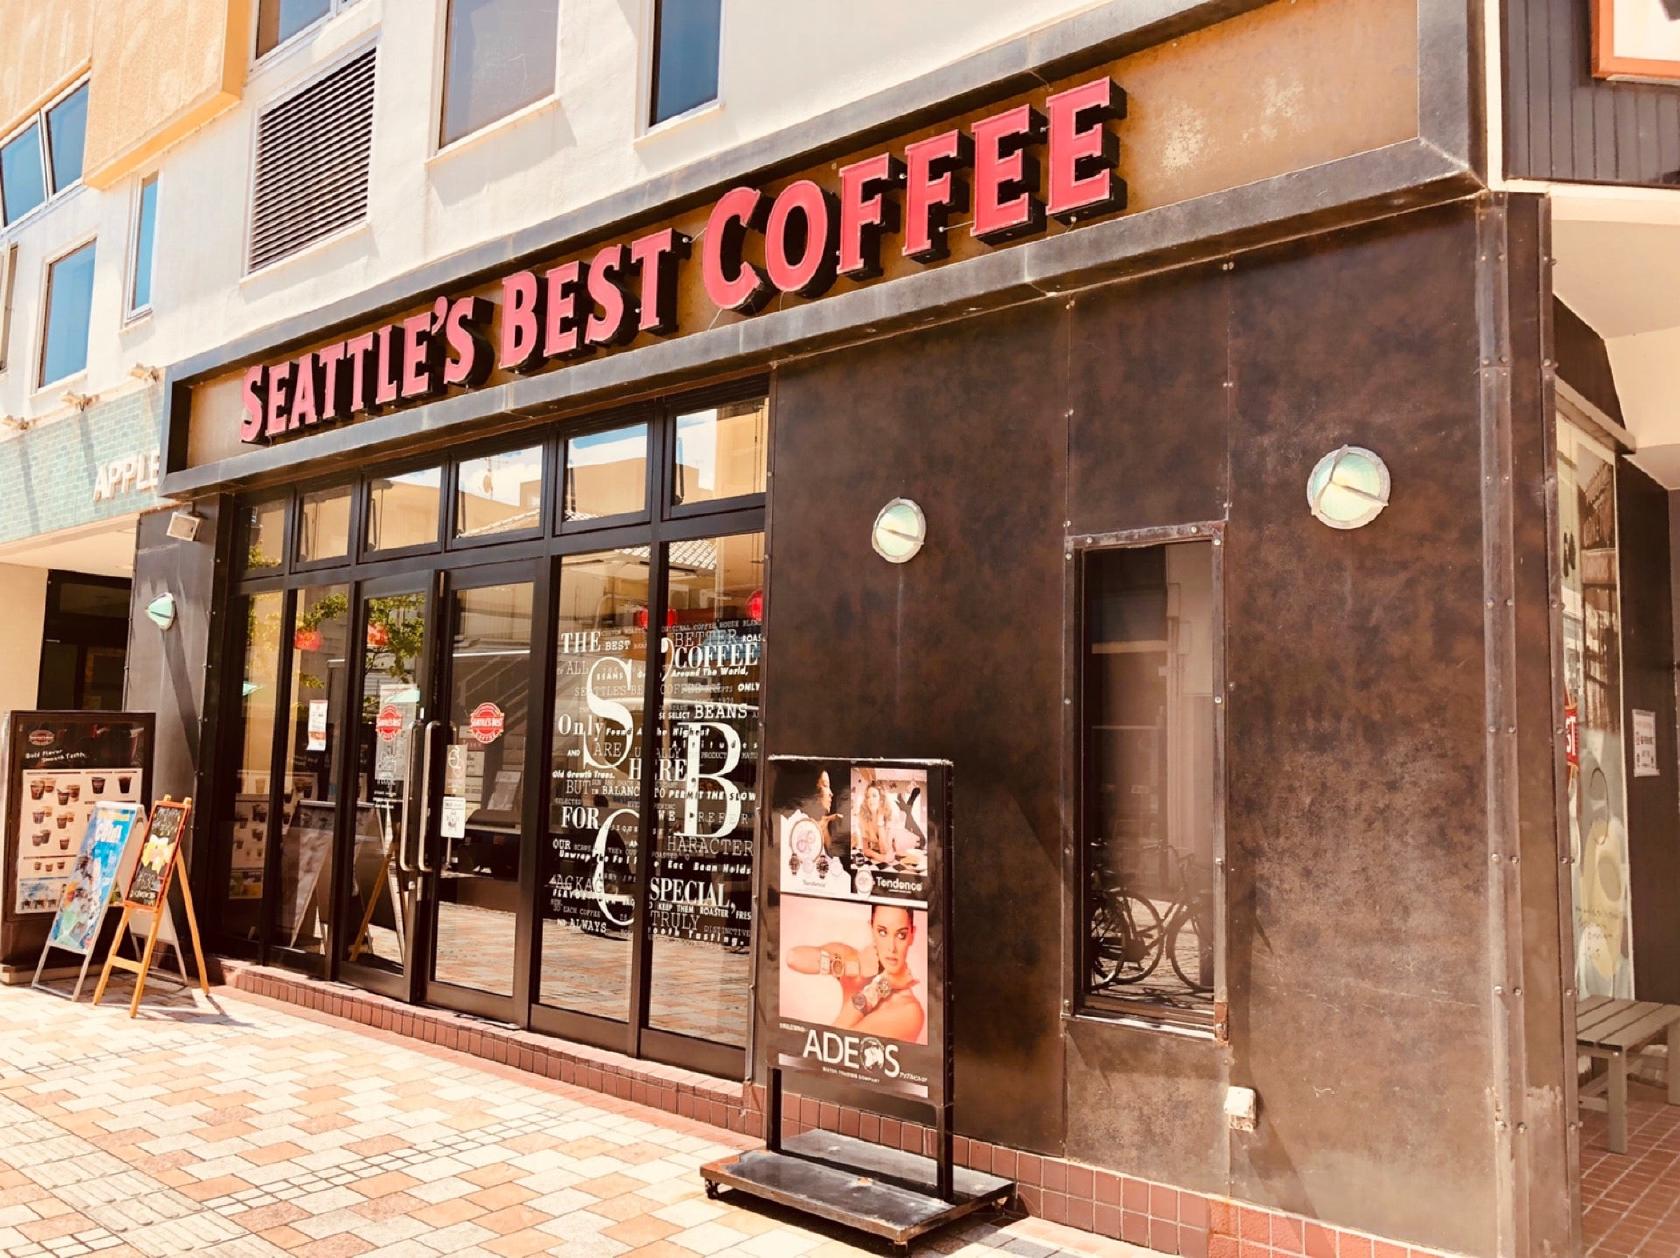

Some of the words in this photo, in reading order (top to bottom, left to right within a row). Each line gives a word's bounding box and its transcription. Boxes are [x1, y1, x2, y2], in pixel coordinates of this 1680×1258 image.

[240, 296, 477, 443] SEATTLE'S
[499, 227, 673, 369] BEST
[702, 76, 1111, 310] COFFEE
[93, 449, 160, 502] APPLE
[560, 631, 601, 653] THE
[605, 640, 631, 651] BEST
[675, 629, 737, 647] BETTER
[675, 643, 758, 668] COFFEE
[738, 682, 760, 692] ONLY
[694, 704, 748, 719] BEANS
[559, 714, 604, 742] Only
[593, 742, 622, 757] ARE
[566, 780, 592, 795] BUT
[602, 785, 640, 797] BALANC
[561, 806, 600, 830] FOR
[552, 839, 571, 850] OUR
[651, 910, 700, 931] TRULY
[736, 910, 752, 920] FRES
[570, 918, 606, 933] ALWAYS
